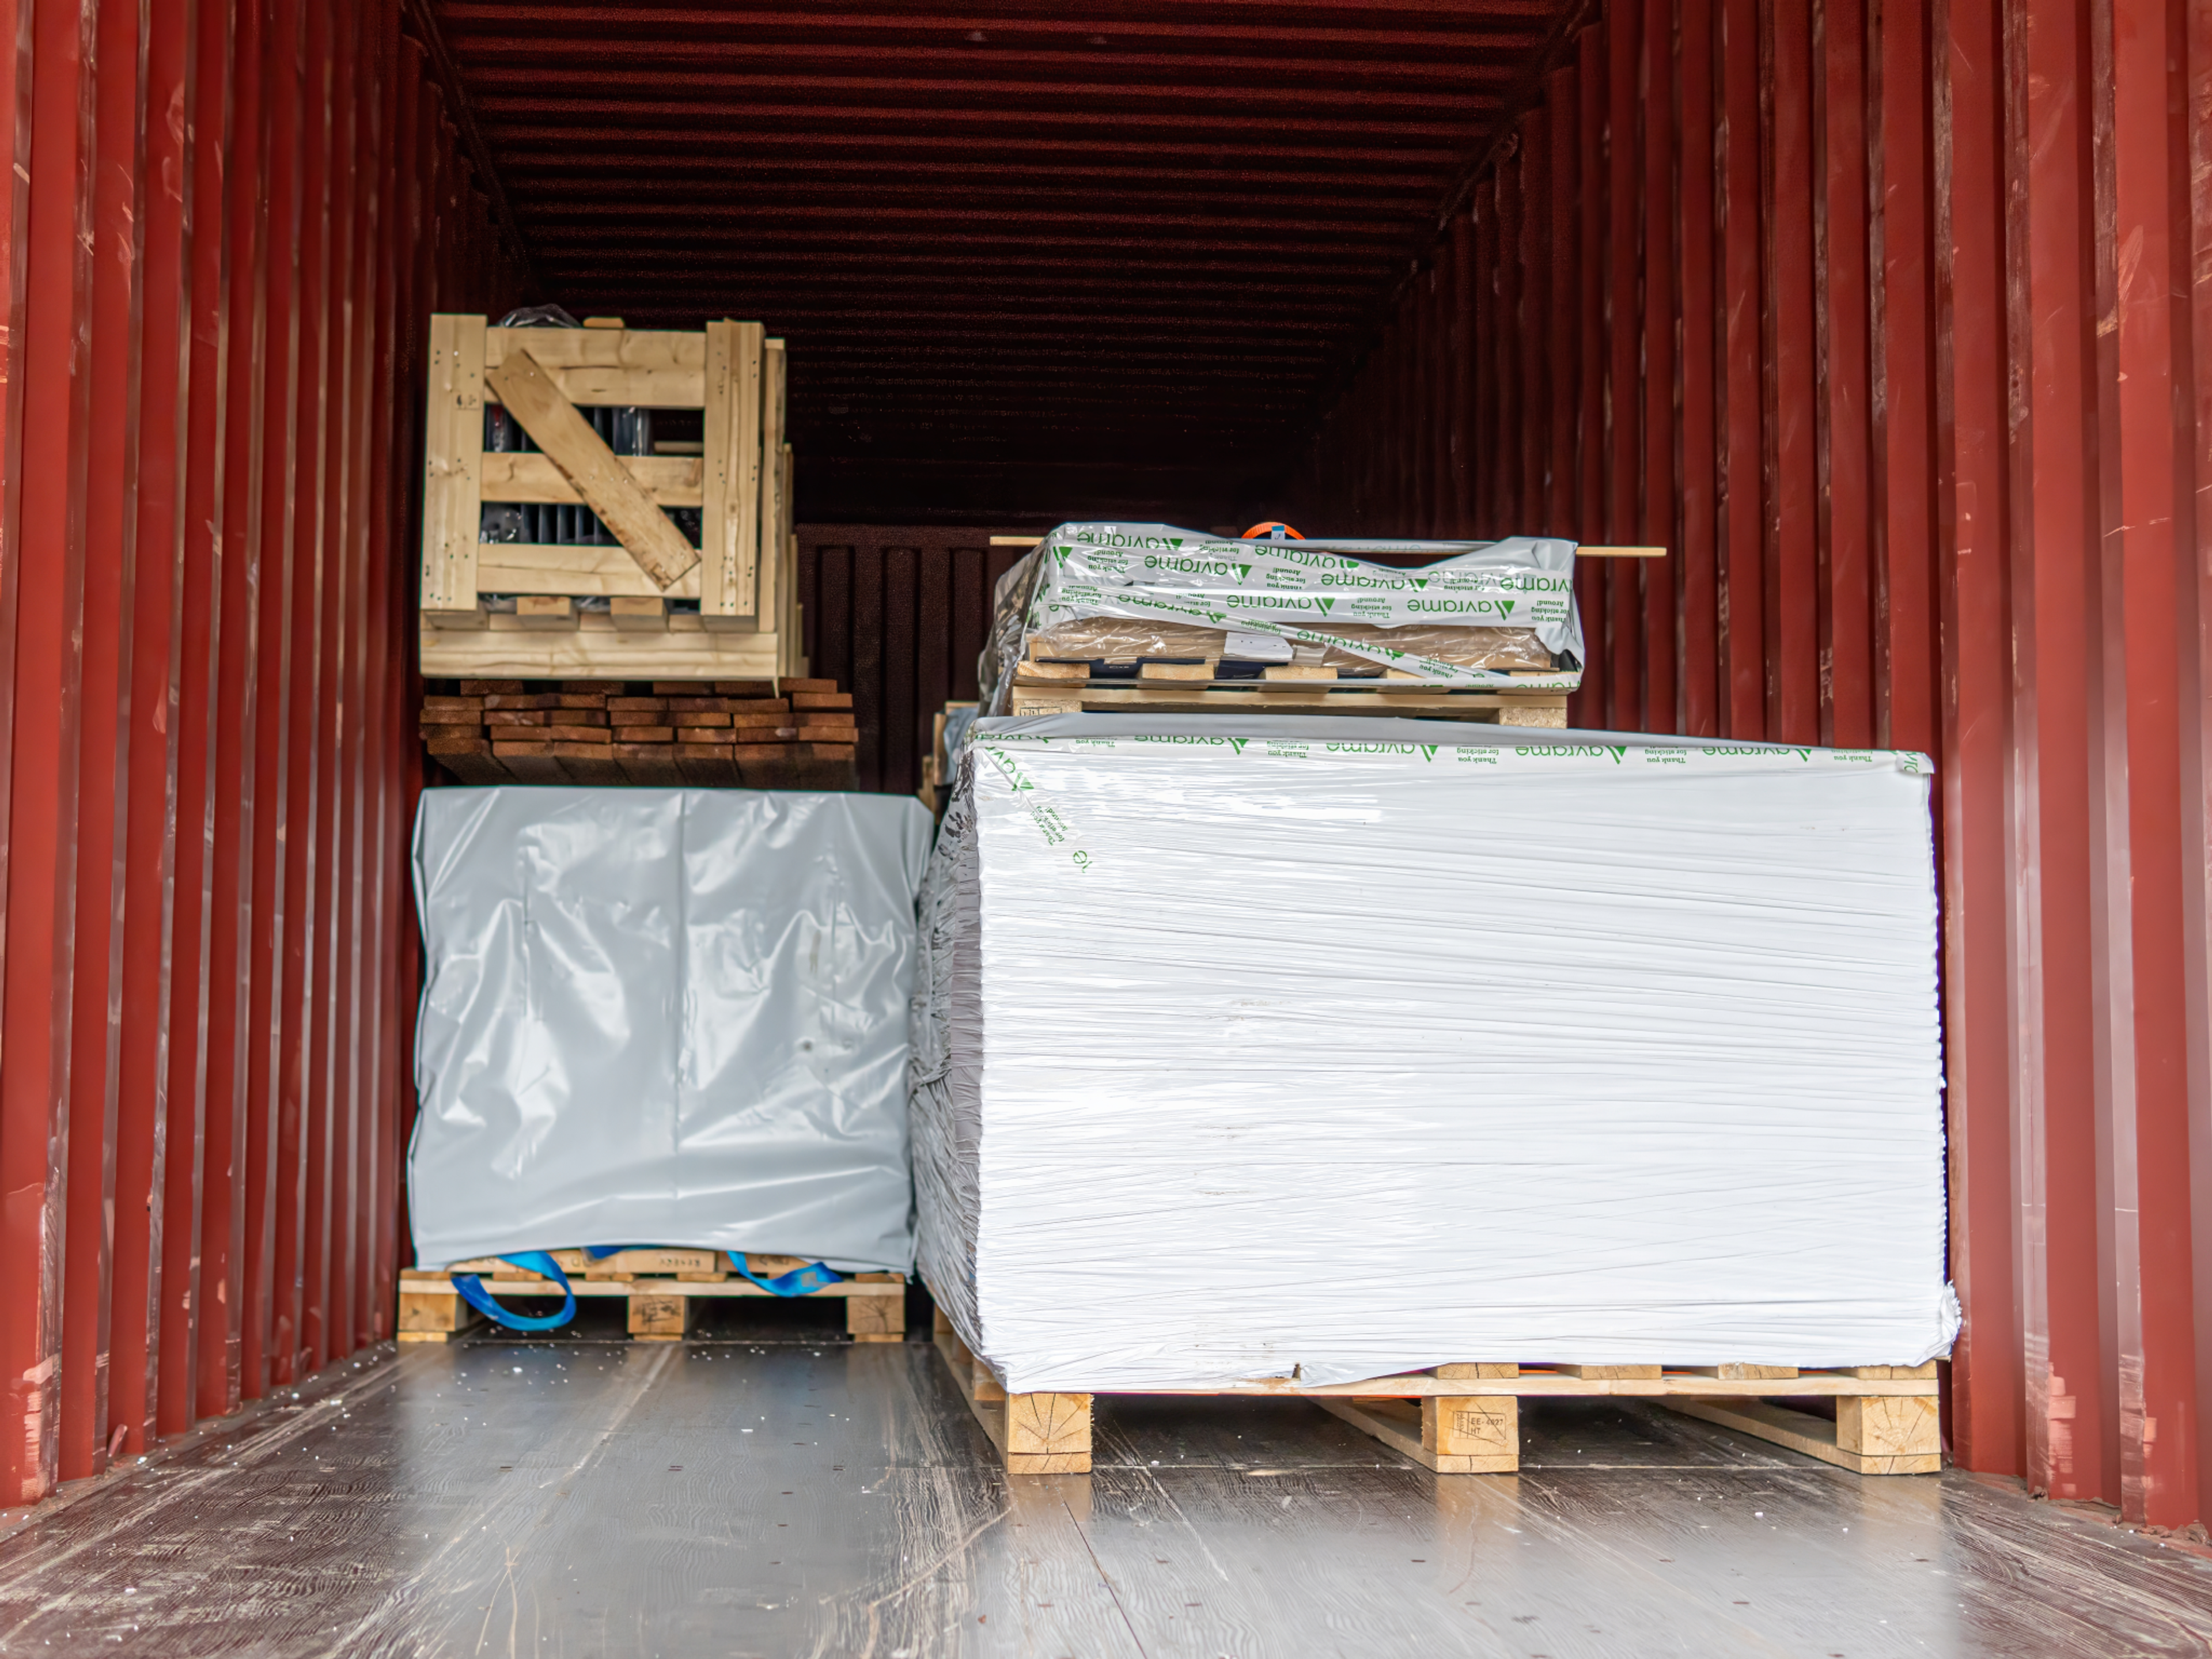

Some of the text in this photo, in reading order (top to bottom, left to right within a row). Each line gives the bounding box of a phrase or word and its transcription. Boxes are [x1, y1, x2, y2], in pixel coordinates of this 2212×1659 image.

[1087, 555, 1117, 565] sticking
[1143, 555, 1228, 575] avrame
[1272, 567, 1301, 575] Around!
[1321, 573, 1405, 590] avrame
[1500, 577, 1572, 593] vrame
[1226, 595, 1312, 609] avrame
[1407, 599, 1492, 613] avrame
[1531, 607, 1559, 615] sticking
[1134, 735, 1225, 745] avrame
[1456, 747, 1487, 755] sticking
[1515, 745, 1604, 756] avrame
[1474, 756, 1497, 764] Thank
